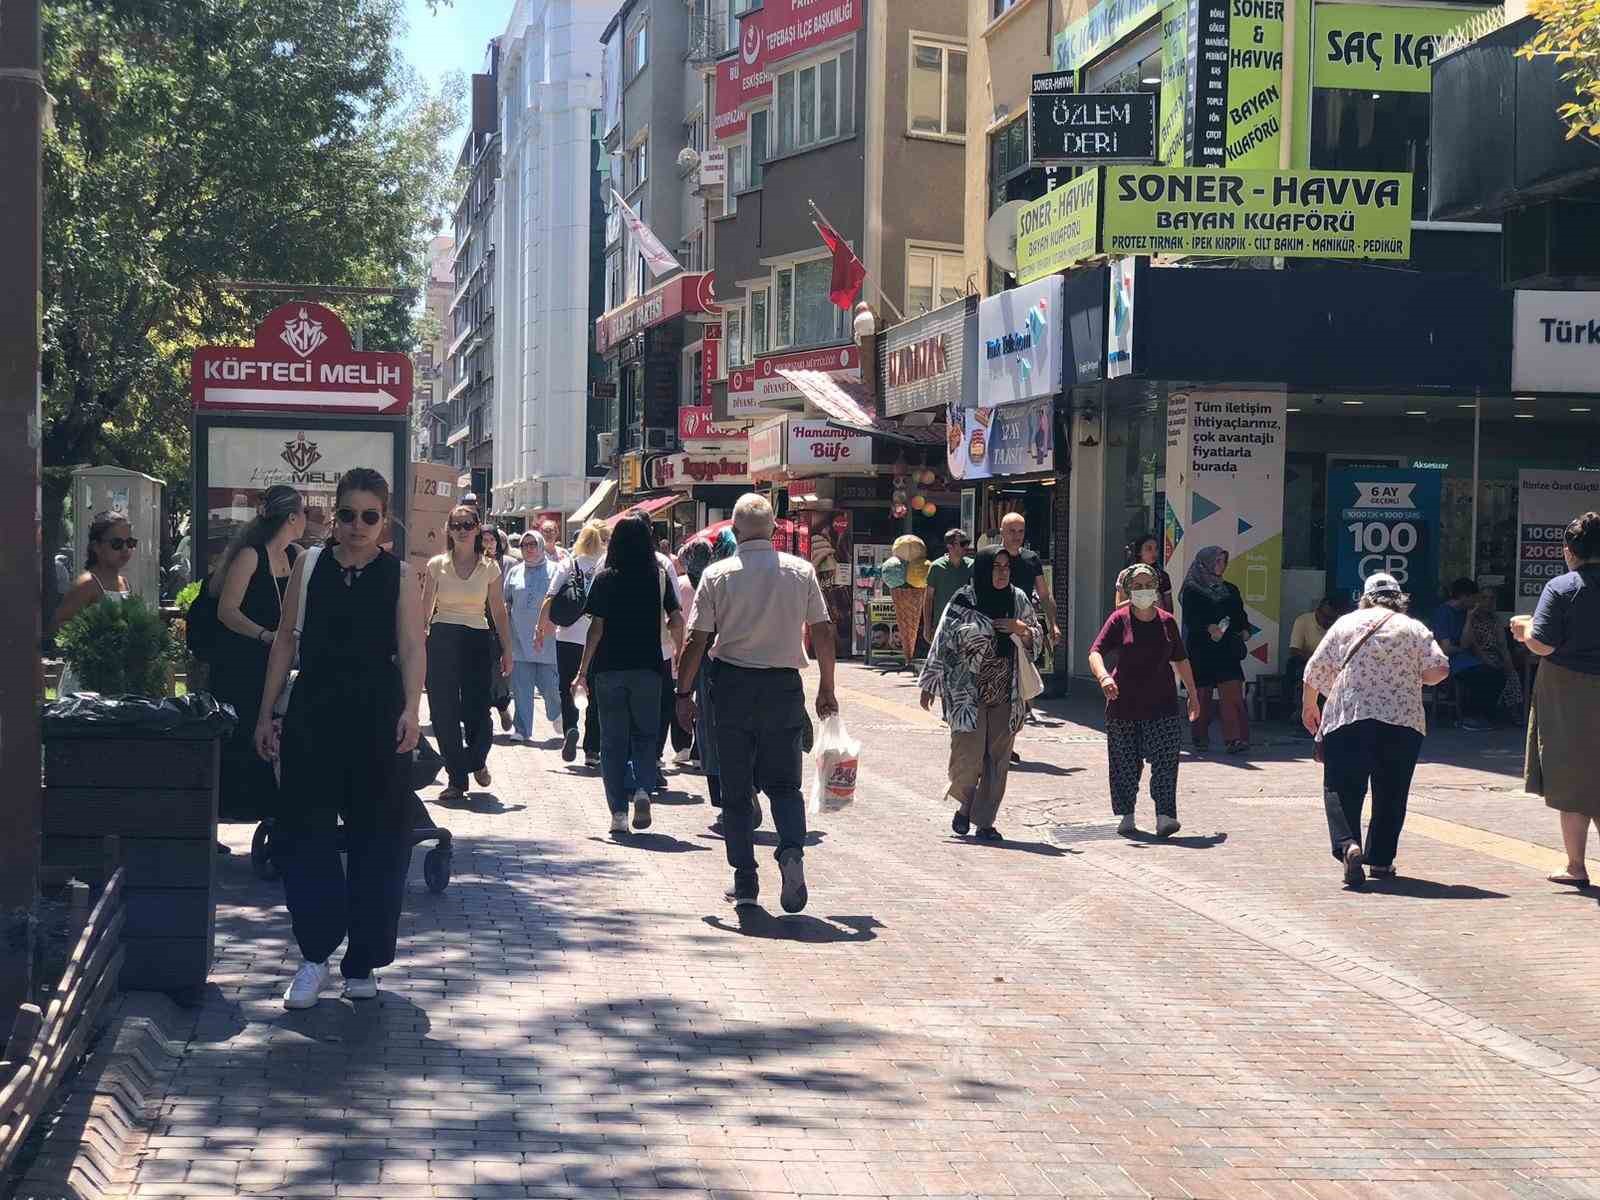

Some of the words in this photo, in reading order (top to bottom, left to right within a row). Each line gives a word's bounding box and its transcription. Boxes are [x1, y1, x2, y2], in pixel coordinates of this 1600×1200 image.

[766, 25, 796, 52] TEPEBAŞI
[1230, 48, 1283, 71] HAVVA
[1327, 29, 1383, 71] SAÇ
[1052, 96, 1131, 126] ÖZLEM
[1229, 84, 1280, 126] BAYAN
[1063, 131, 1118, 153] DERİ
[1225, 115, 1280, 162] KUAFÖRÜ
[1117, 174, 1245, 206] SONER
[1273, 176, 1401, 208] HAVVA
[1020, 199, 1052, 238] SONER
[1058, 177, 1095, 218] HAVVA
[1156, 211, 1235, 231] BAYAN
[1244, 209, 1355, 232] KUAFÖRÜ
[1112, 235, 1147, 249] PROTEZ
[1149, 235, 1184, 250] TIRNAK
[1540, 318, 1600, 344] Türk
[204, 357, 312, 383] KÖFTECİ
[320, 361, 401, 385] MELİH
[1194, 402, 1222, 414] Tüm
[1225, 402, 1272, 416] iletişim
[793, 426, 863, 441] Hamamyo
[1194, 417, 1281, 430] ihtiyaçlarınız,
[1193, 432, 1216, 445] çok
[1218, 433, 1274, 446] avantajlı
[809, 442, 851, 462] Büfe
[1193, 446, 1252, 459] fiyatlarla
[1193, 460, 1238, 472] burada
[1371, 487, 1379, 497] 6
[1382, 487, 1399, 497] AY
[1348, 521, 1418, 553] 100
[1527, 527, 1543, 540] 10
[1544, 527, 1564, 540] GB
[1526, 545, 1544, 558] 20
[1544, 546, 1563, 558] GB
[1358, 555, 1409, 585] GB
[1524, 563, 1543, 576] 40
[1544, 564, 1564, 576] GB
[1523, 581, 1542, 594] 60
